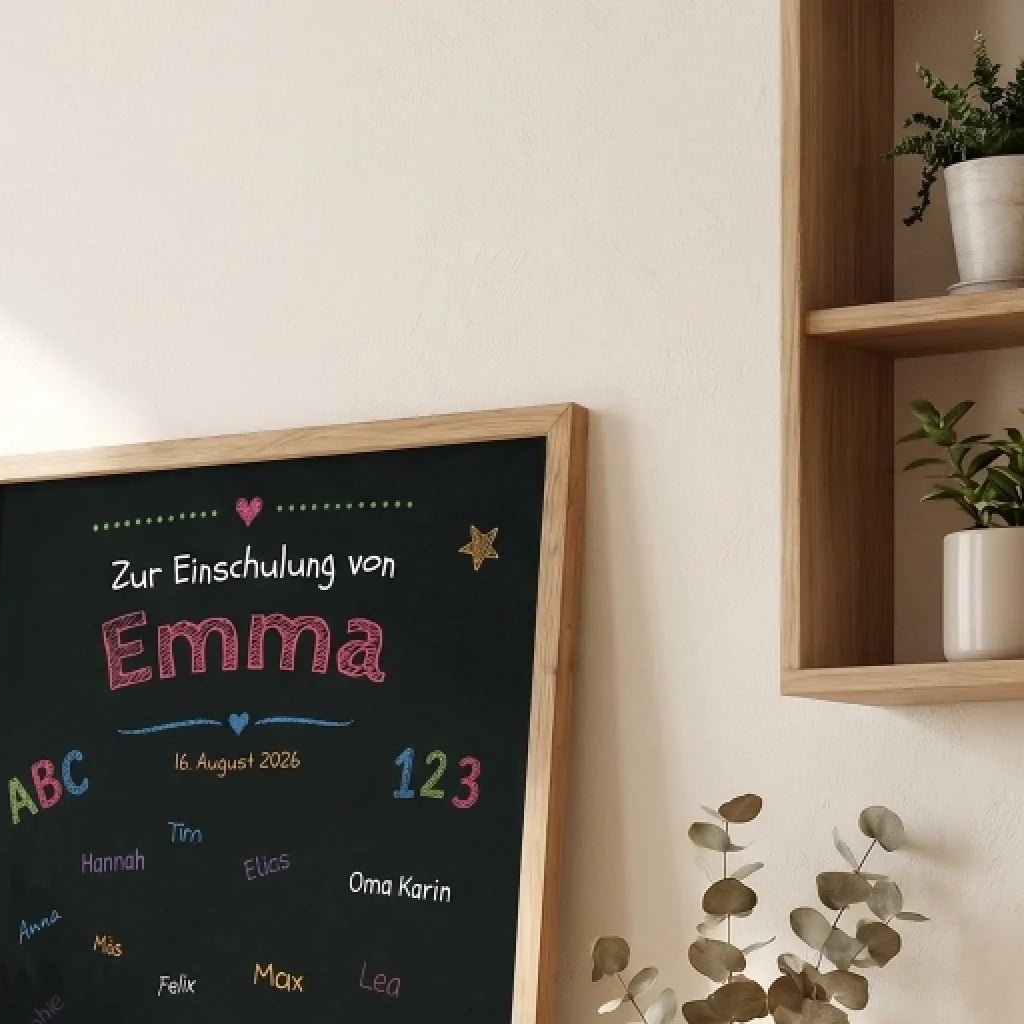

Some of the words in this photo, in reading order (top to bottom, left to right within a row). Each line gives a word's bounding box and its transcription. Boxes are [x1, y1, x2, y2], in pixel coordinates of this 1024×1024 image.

[112, 560, 163, 590] Zur
[174, 544, 336, 591] Einschulung
[348, 553, 396, 579] von
[101, 609, 387, 691] Emma
[174, 751, 192, 771] 16.
[196, 751, 255, 779] August
[259, 750, 301, 769] 2026
[167, 821, 203, 843] Tim
[81, 848, 145, 874] Hannah
[349, 871, 392, 896] Oma
[397, 875, 451, 903] Karin
[19, 909, 63, 944] Anna
[157, 973, 197, 997] Felix
[253, 962, 305, 993] Max
[359, 960, 401, 999] Lea
